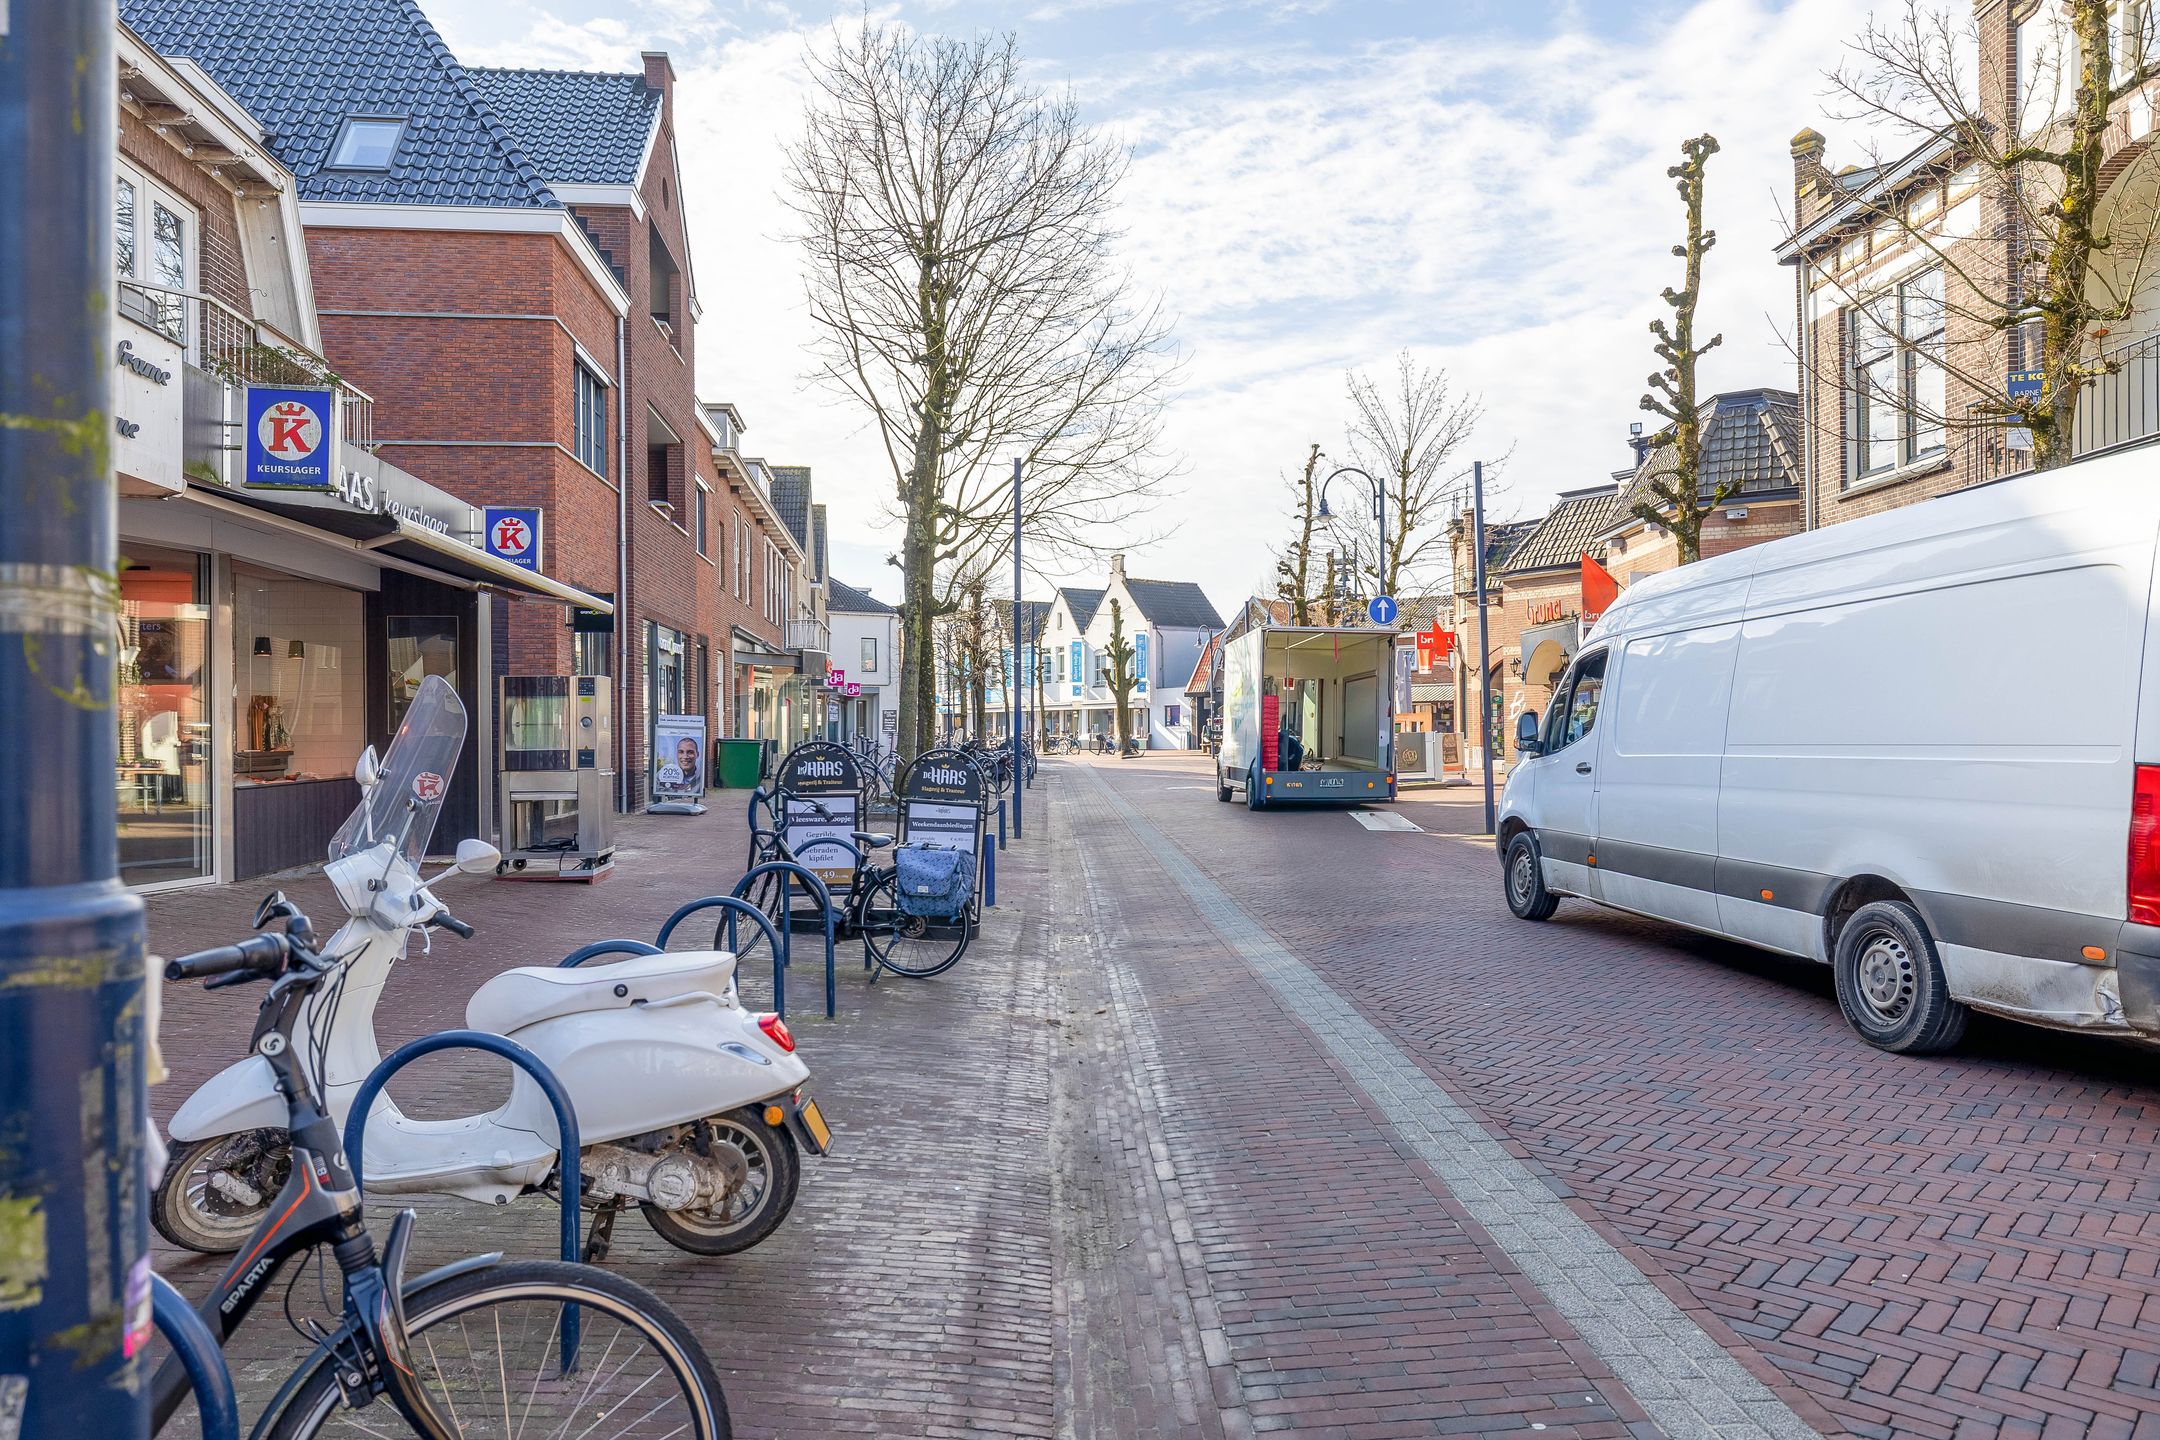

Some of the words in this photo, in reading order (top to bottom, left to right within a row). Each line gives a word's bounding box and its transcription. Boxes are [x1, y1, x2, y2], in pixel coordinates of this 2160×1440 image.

[2010, 374, 2025, 383] TE
[268, 417, 311, 452] K
[257, 464, 321, 475] KEURSLAGER
[498, 528, 524, 549] K
[828, 672, 843, 684] da
[847, 685, 859, 694] da
[663, 767, 680, 775] 20%
[930, 766, 967, 786] HAAS
[221, 1257, 274, 1314] SPARTA
